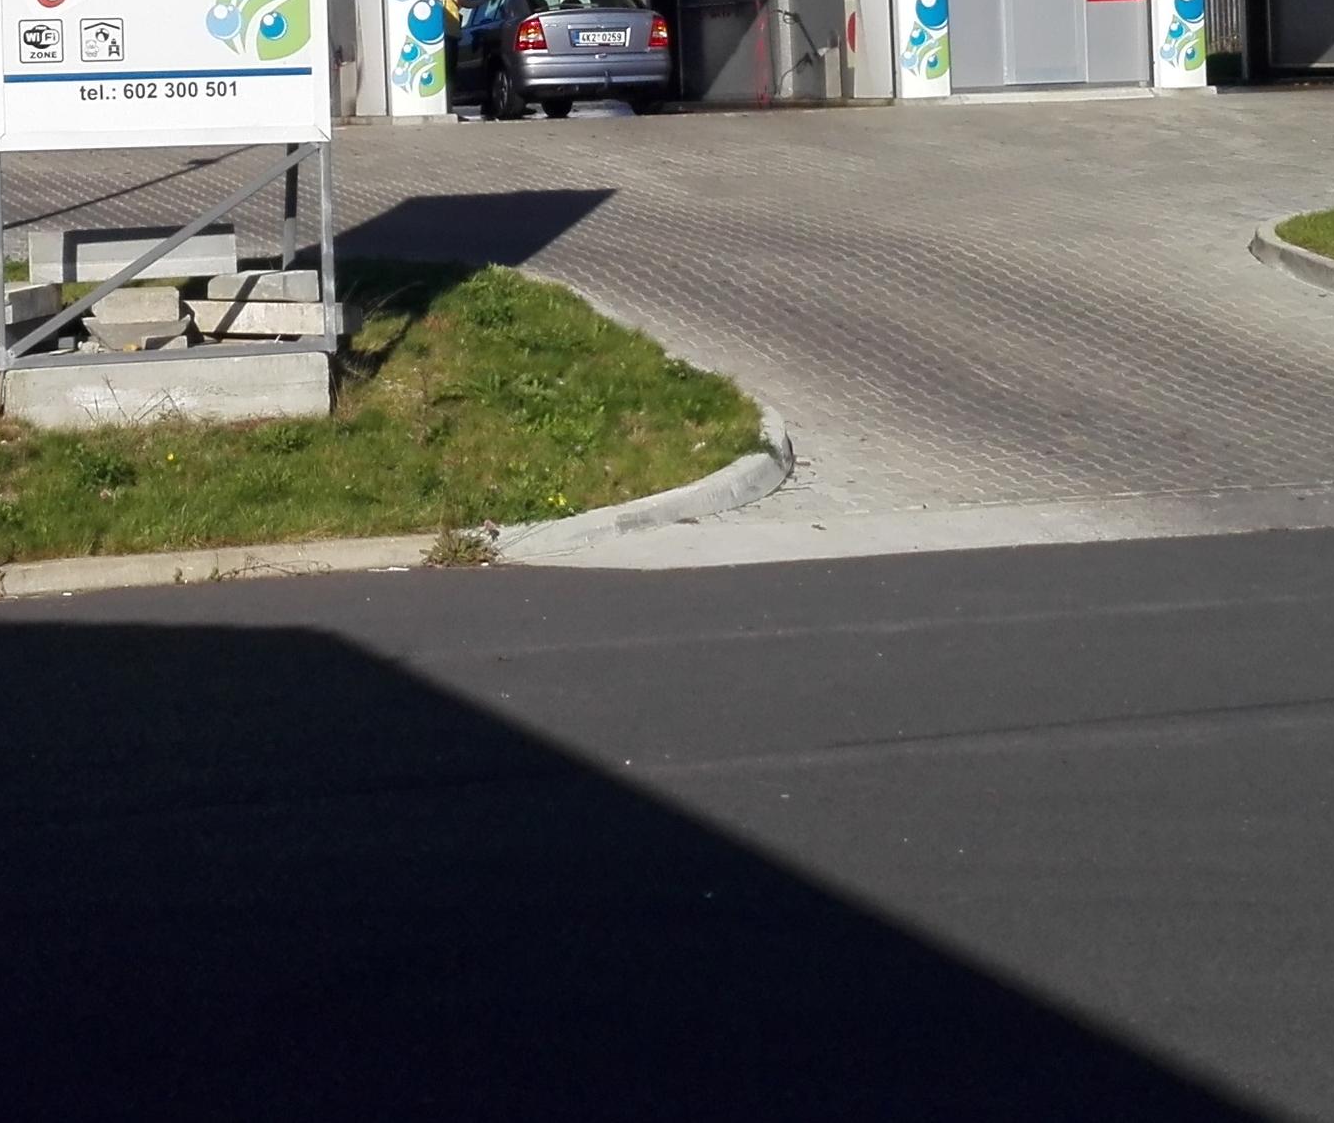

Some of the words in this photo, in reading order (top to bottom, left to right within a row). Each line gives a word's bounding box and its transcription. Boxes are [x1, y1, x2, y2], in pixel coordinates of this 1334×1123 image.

[80, 84, 117, 100] tel.:
[123, 83, 157, 99] 602
[164, 81, 198, 98] 300
[205, 80, 237, 97] 501
